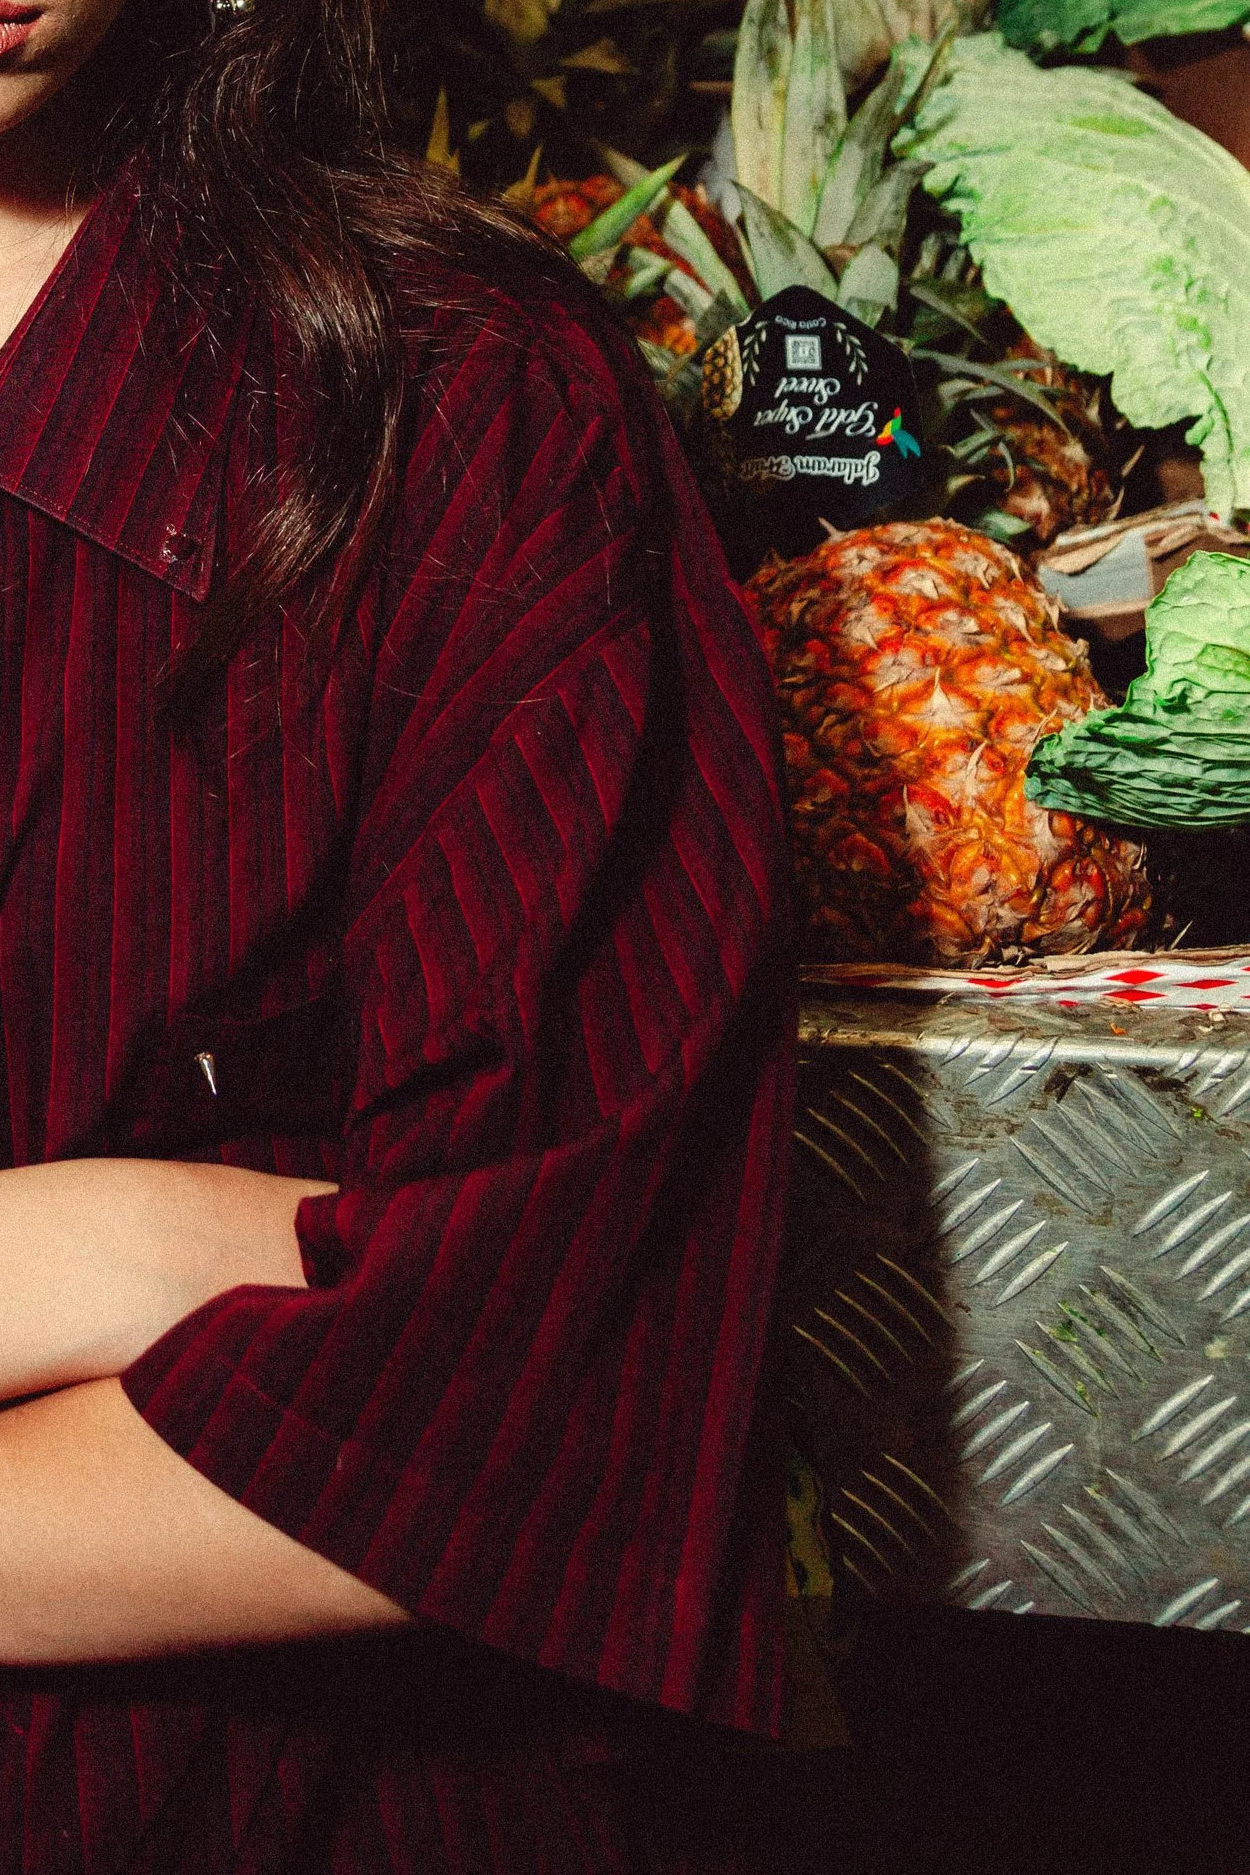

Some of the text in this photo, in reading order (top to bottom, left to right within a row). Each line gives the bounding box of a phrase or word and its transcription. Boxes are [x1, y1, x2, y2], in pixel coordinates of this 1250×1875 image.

[773, 376, 841, 406] Sweet
[753, 398, 879, 441] Gold Super
[793, 450, 881, 486] Jalaram
